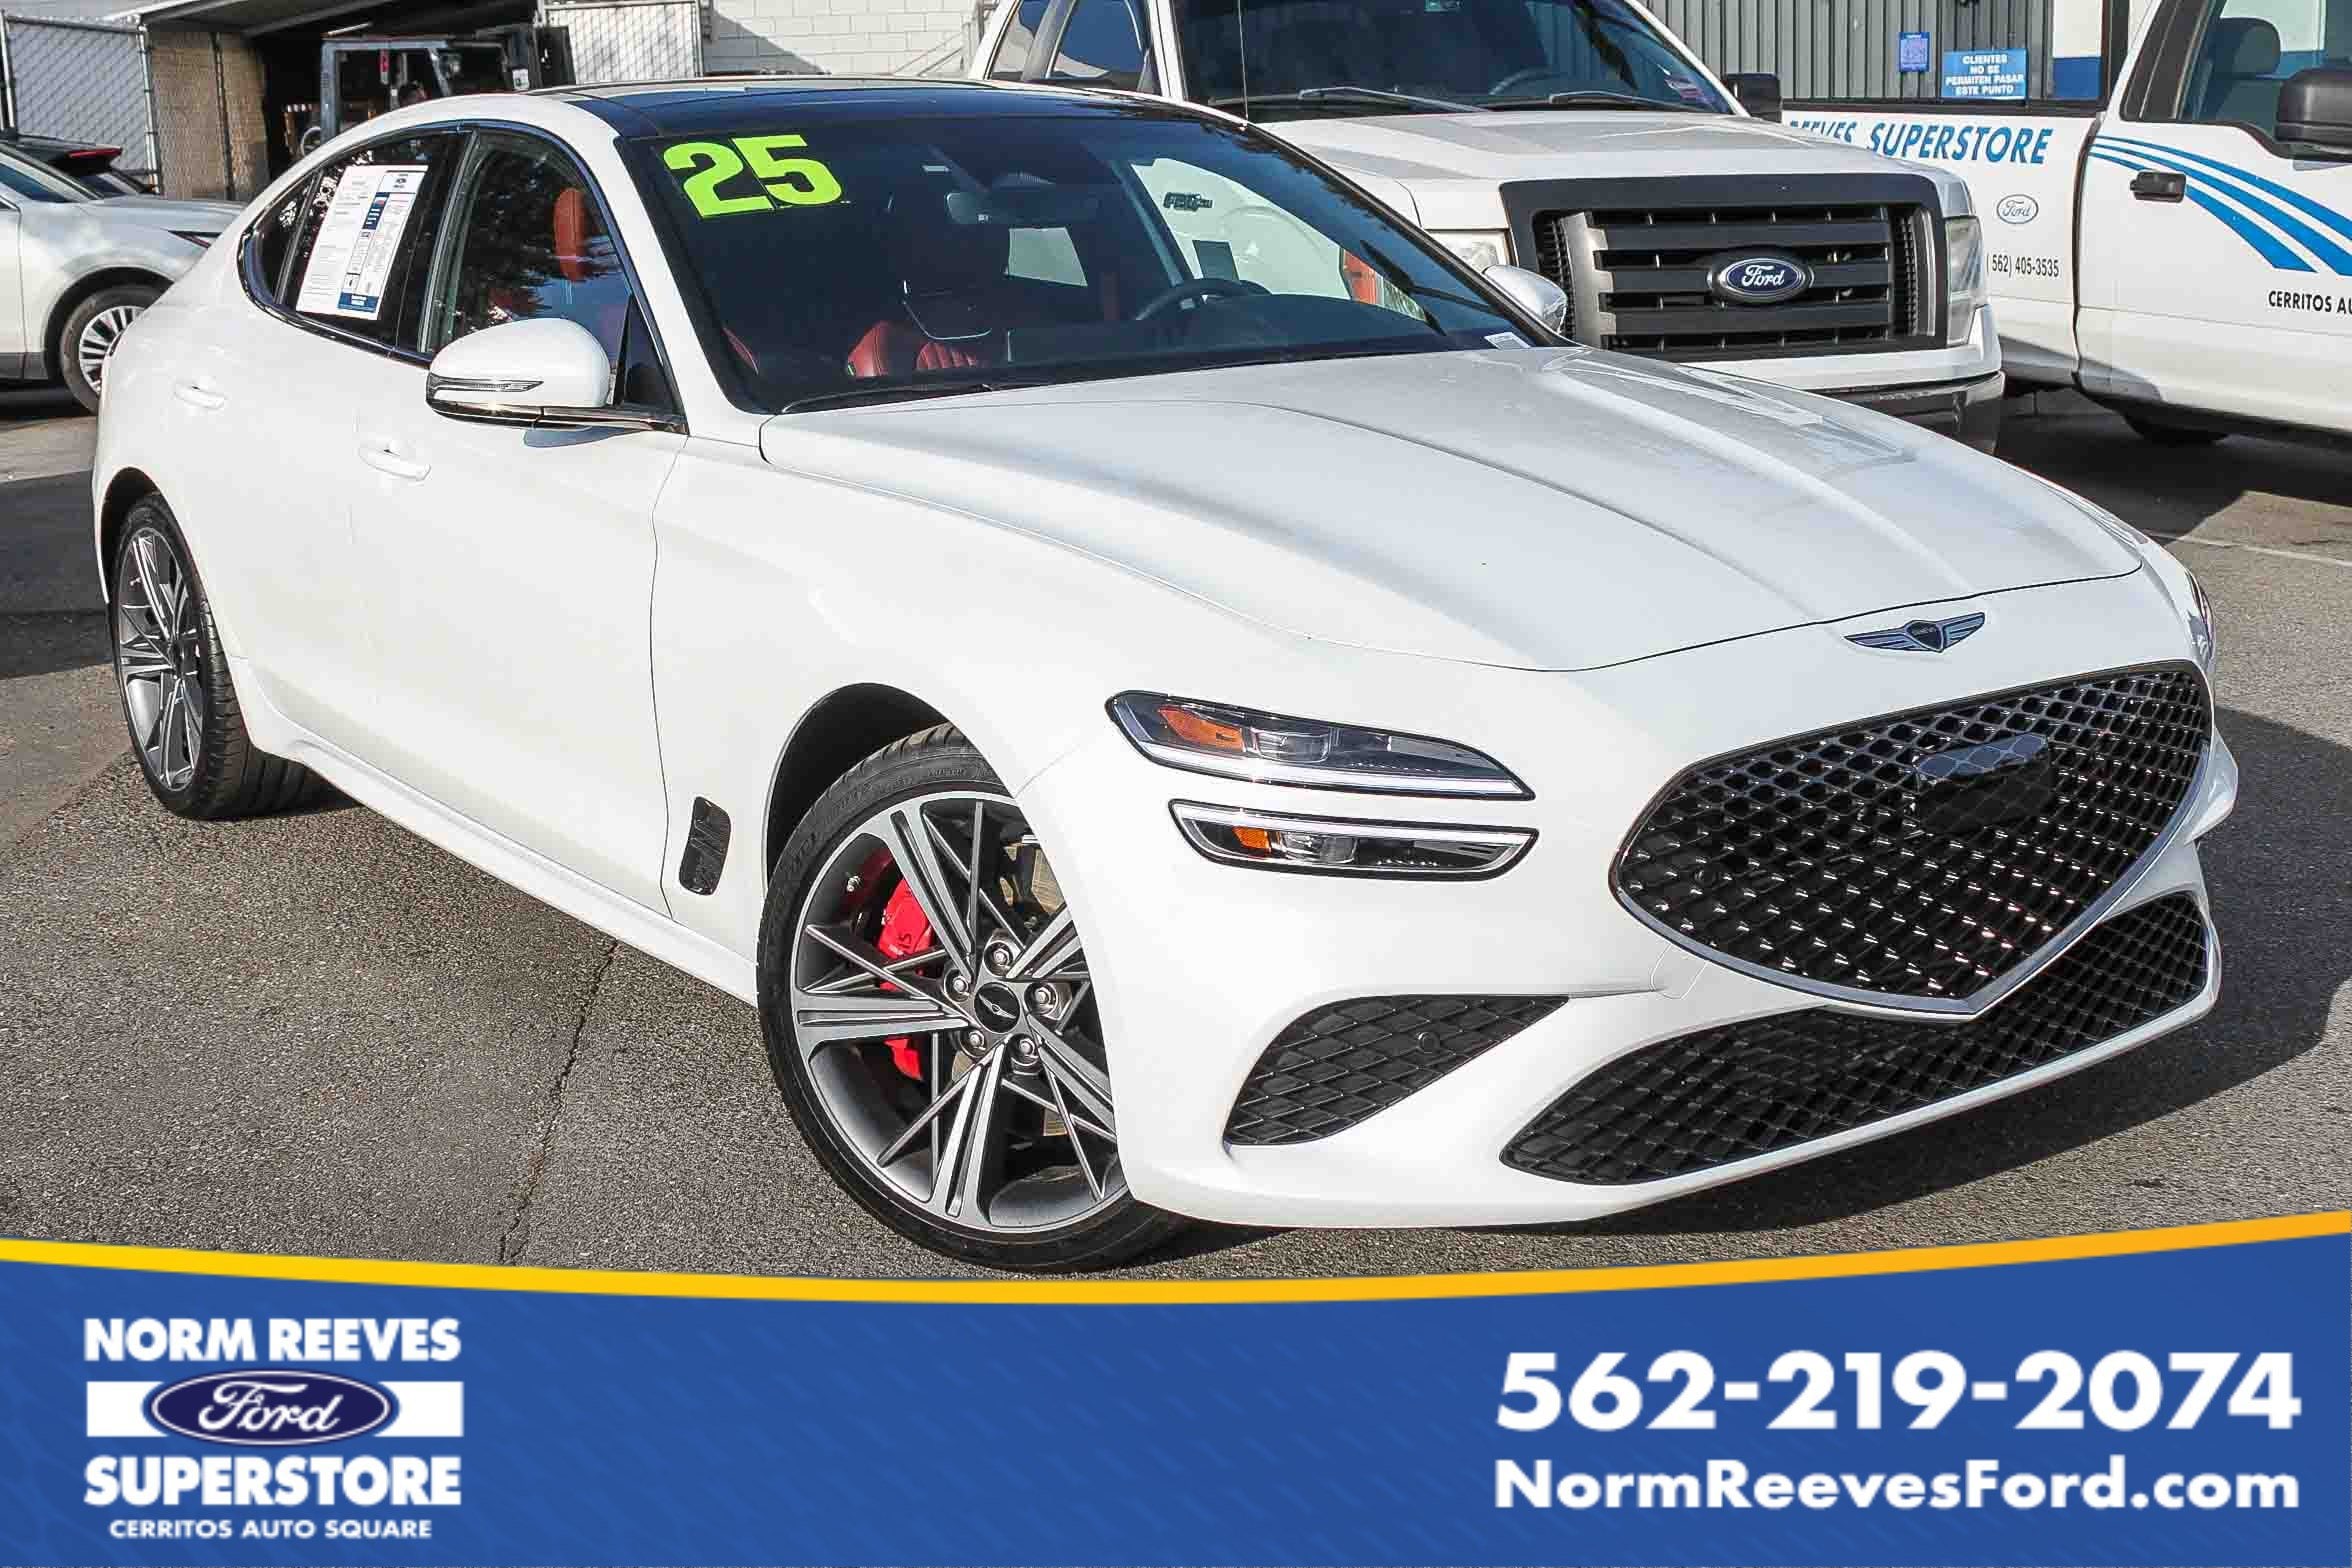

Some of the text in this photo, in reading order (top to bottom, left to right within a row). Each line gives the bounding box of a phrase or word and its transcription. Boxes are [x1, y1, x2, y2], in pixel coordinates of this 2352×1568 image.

[1962, 54, 2008, 65] CLIENTES
[1969, 64, 2001, 74] NO SE
[1945, 73, 2025, 86] PERMITEN PASAR
[1955, 85, 2014, 96] ESTE PUNTO
[1869, 122, 2054, 164] SUPERSTORE
[663, 134, 842, 218] 25
[2000, 199, 2031, 217] Ford
[1741, 264, 1785, 287] Ford
[2015, 256, 2060, 278] 405-3535
[2268, 290, 2332, 312] CERRITOS
